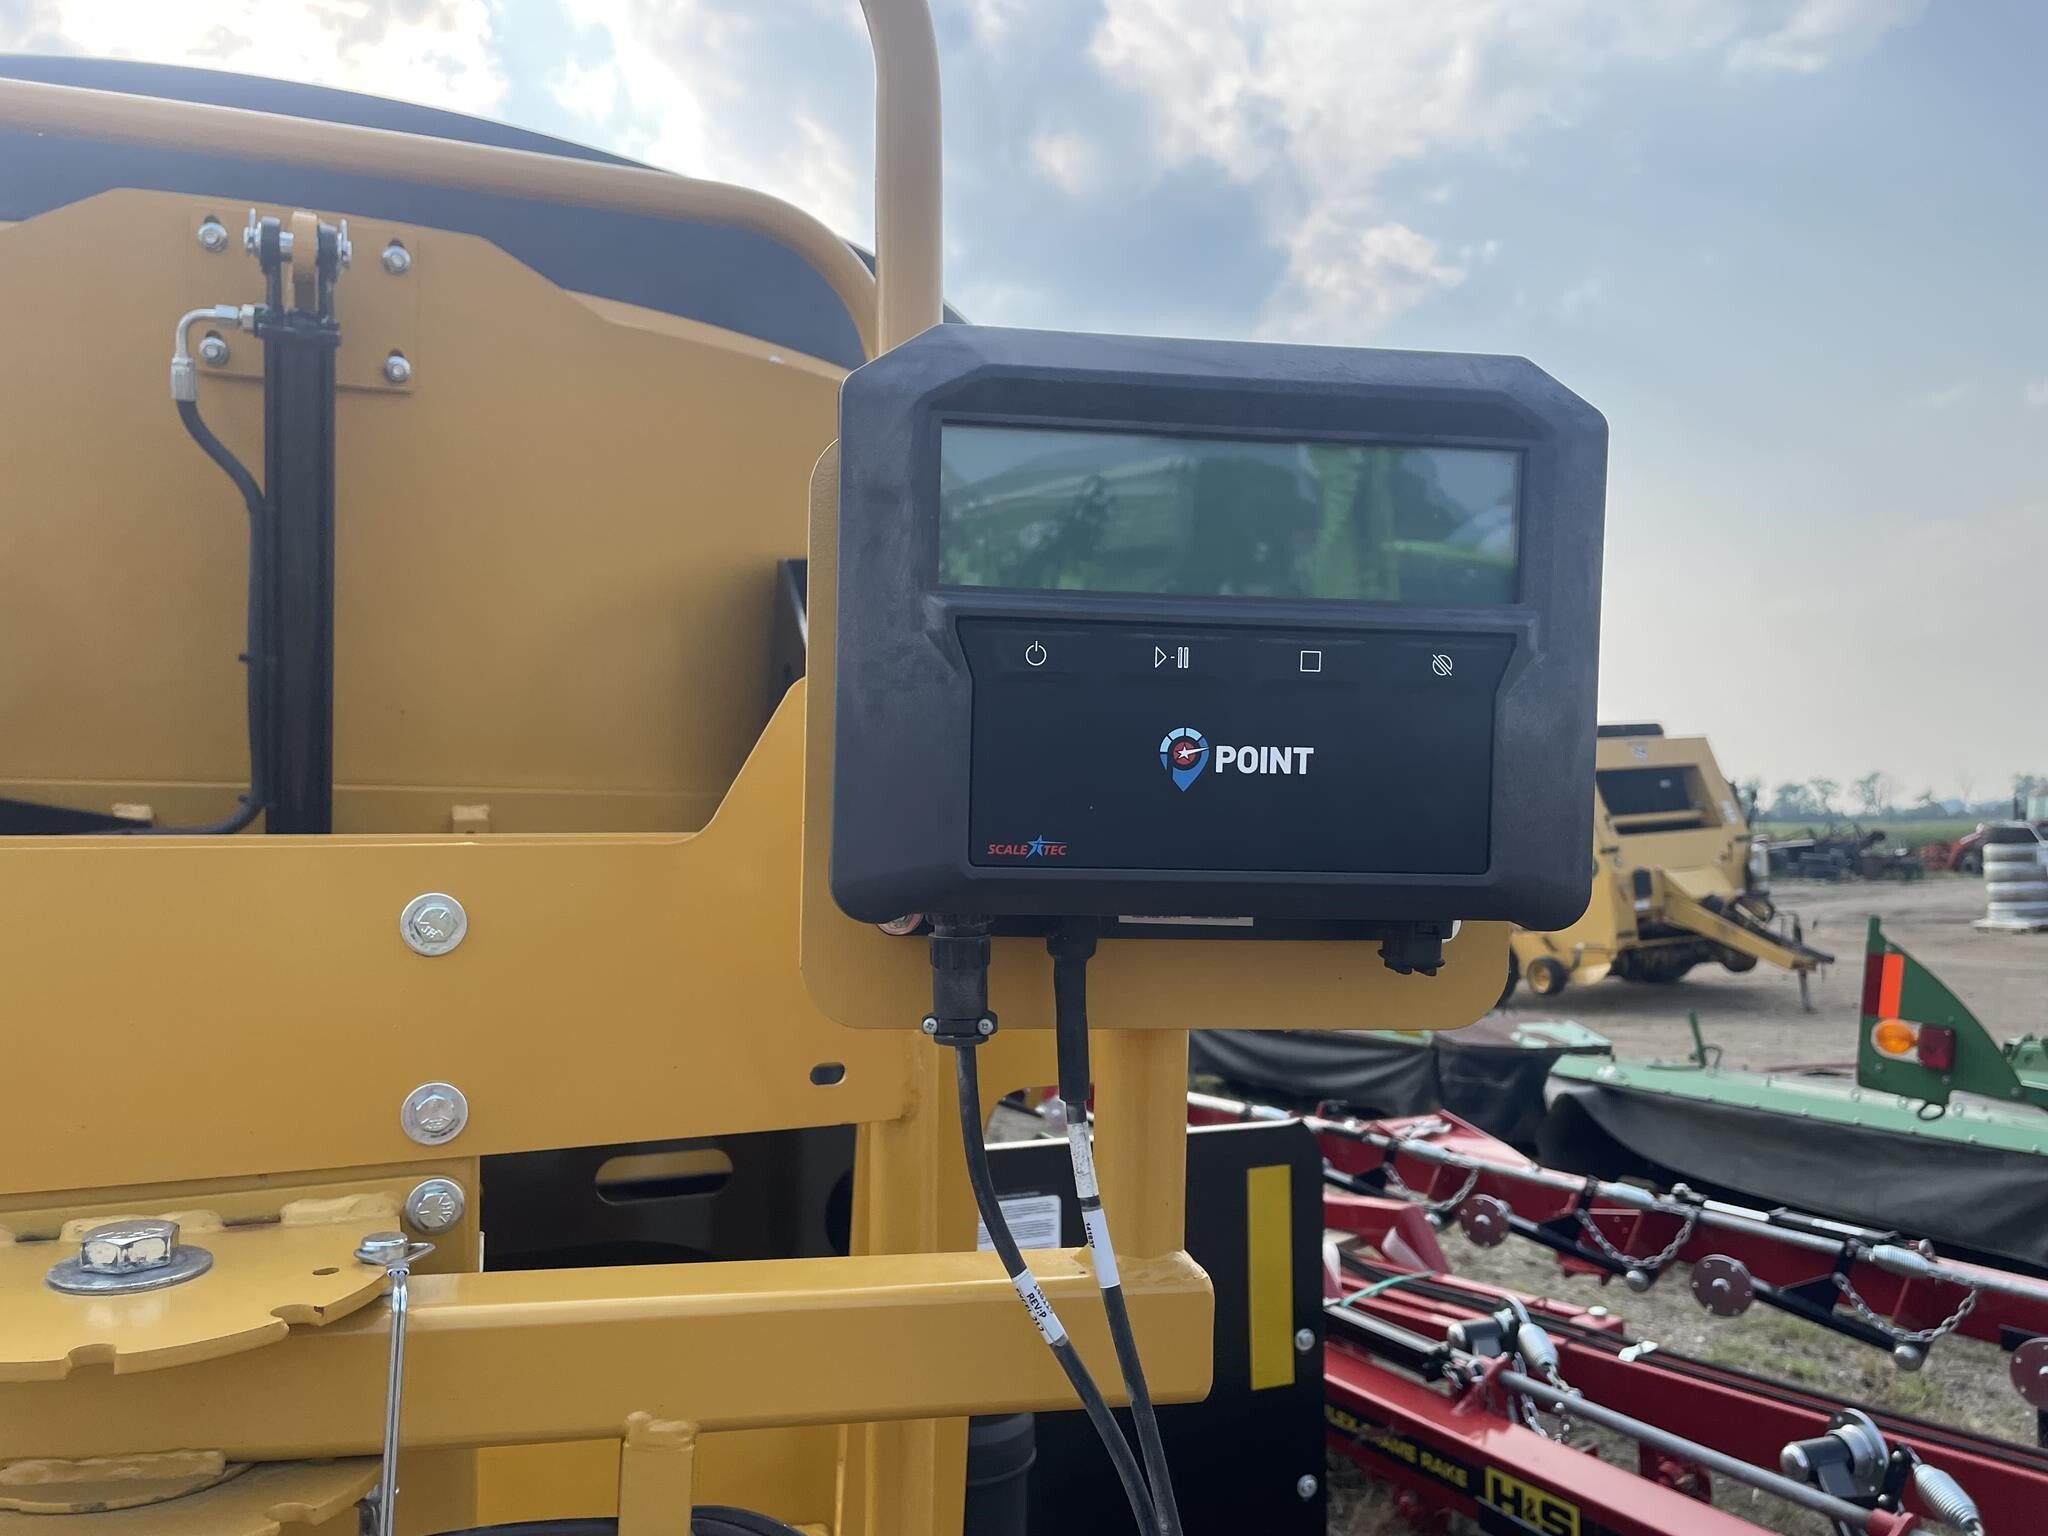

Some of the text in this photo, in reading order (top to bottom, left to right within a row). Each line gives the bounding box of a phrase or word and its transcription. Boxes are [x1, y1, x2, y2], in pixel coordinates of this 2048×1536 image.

[1215, 745, 1315, 775] POINT
[987, 844, 1028, 855] SCALE
[1026, 1292, 1048, 1318] REV:P
[1420, 1451, 1468, 1490] RAKE
[1492, 1477, 1573, 1536] H&S
